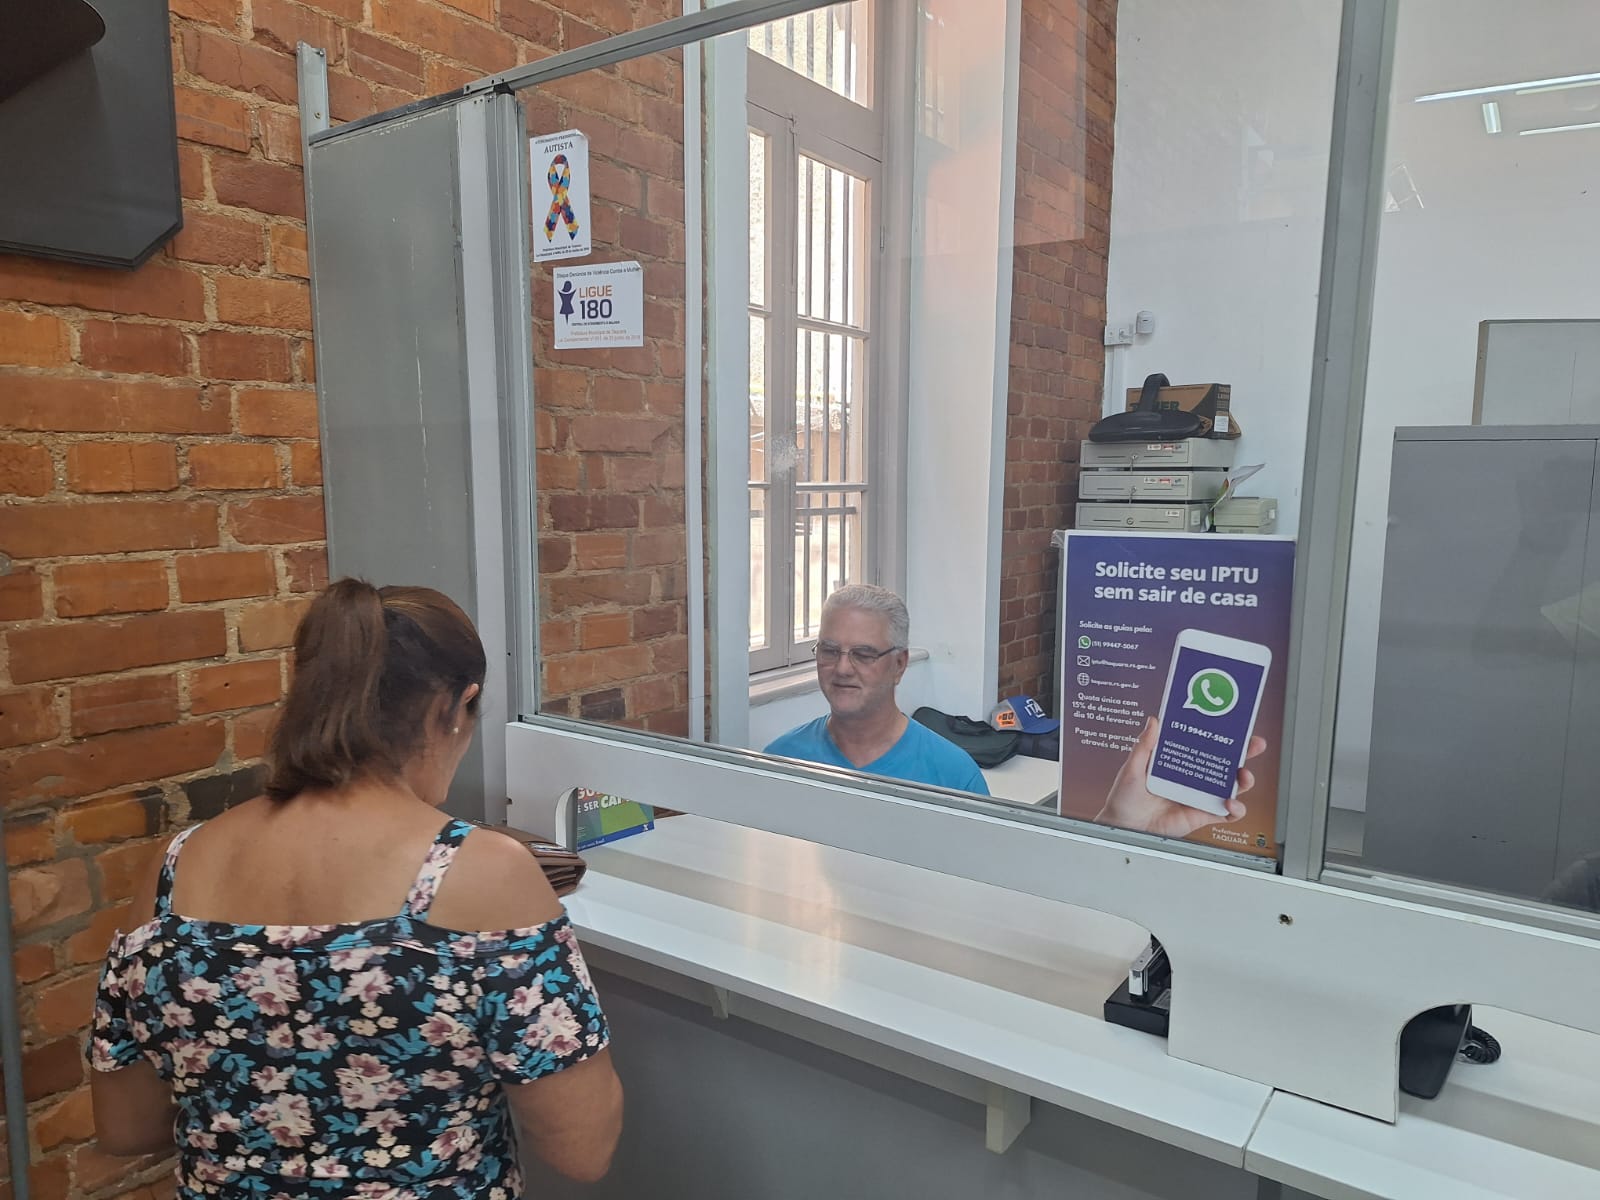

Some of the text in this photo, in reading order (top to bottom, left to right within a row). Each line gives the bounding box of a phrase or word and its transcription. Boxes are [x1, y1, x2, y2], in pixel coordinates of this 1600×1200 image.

[543, 140, 574, 154] AUTISTA
[579, 285, 613, 298] LIGUE
[579, 299, 612, 320] 180
[1095, 561, 1259, 584] Solicite seu IPTU
[1094, 585, 1259, 607] sem sair de casa
[1079, 620, 1103, 629] Solicite
[1113, 623, 1133, 633] guias
[1072, 701, 1086, 709] 15%
[1087, 703, 1096, 711] de
[1097, 705, 1131, 715] desconto
[1101, 695, 1121, 704] única
[1122, 699, 1138, 707] com
[1073, 710, 1141, 726] dia 10 de fevereiro
[1074, 727, 1098, 737] Pague
[1108, 733, 1140, 743] parcelas
[1171, 720, 1235, 746] (51) 99447-5067
[1081, 738, 1109, 748] através
[1162, 747, 1195, 762] MUNICIPAL
[1205, 761, 1224, 771] NOME
[1164, 740, 1190, 752] NÚMERO
[1199, 751, 1231, 766] INSCRIÇÃO
[1160, 753, 1171, 761] CPF
[1181, 760, 1224, 778] PROPRIETÁRIO
[1163, 762, 1194, 776] ENDEREÇO
[1204, 775, 1227, 788] IMÓVEL
[583, 800, 600, 812] SER
[1211, 827, 1241, 837] Prefeitura
[1212, 832, 1248, 846] TAQUARA
